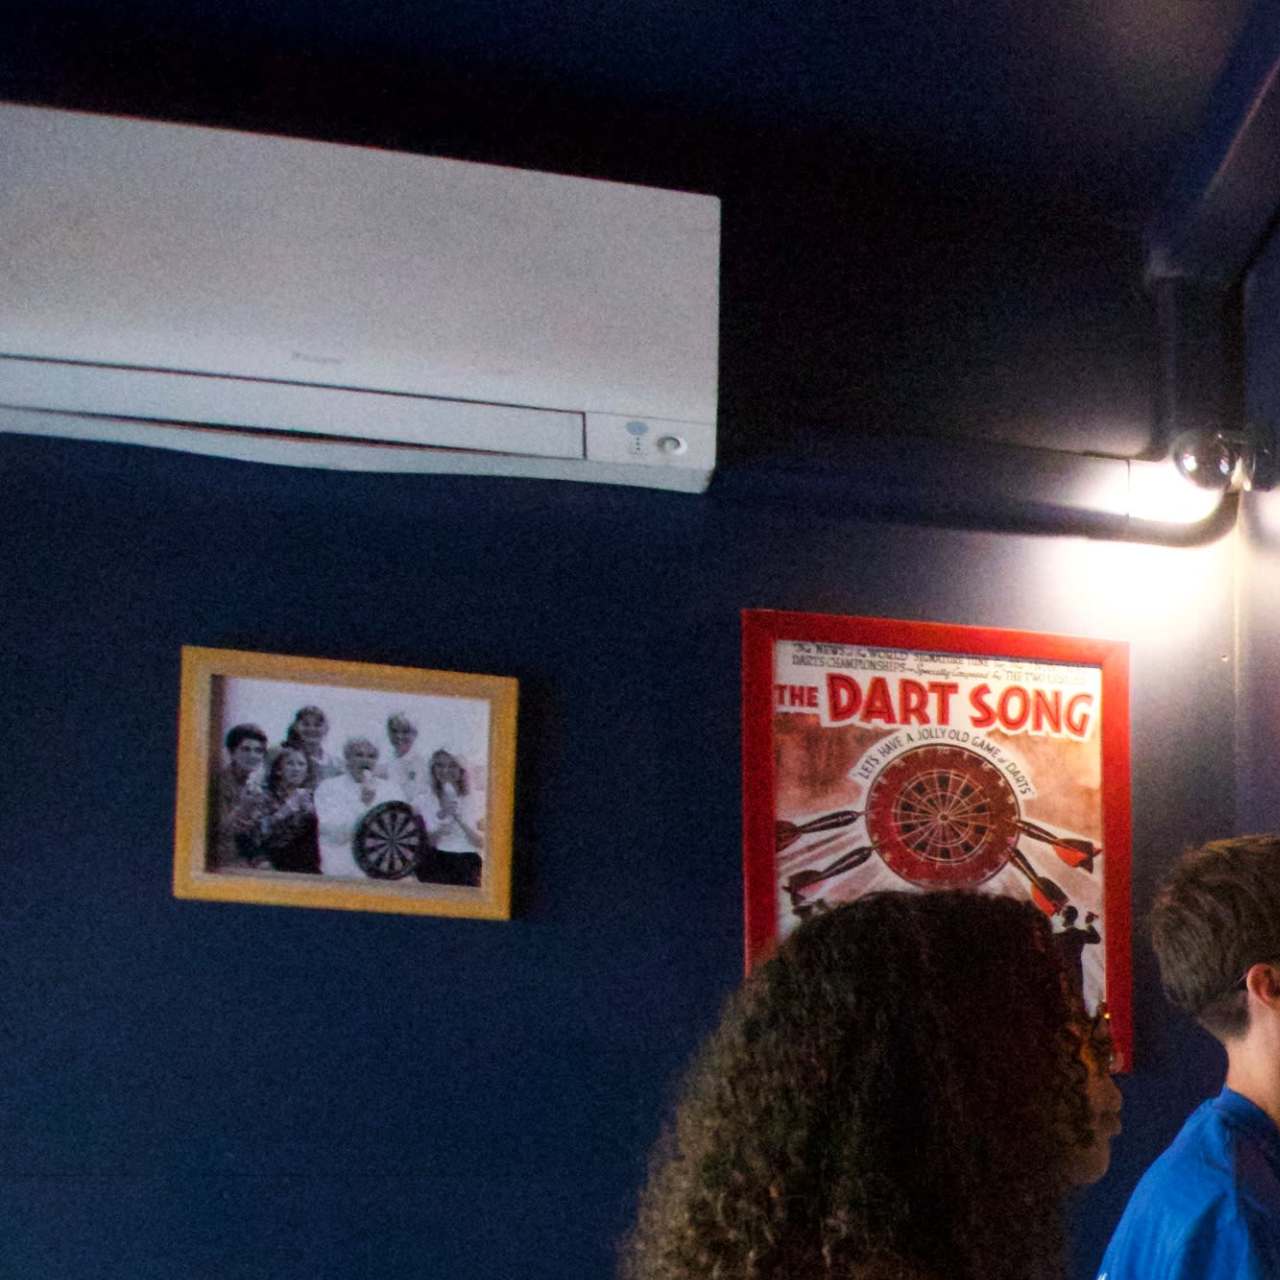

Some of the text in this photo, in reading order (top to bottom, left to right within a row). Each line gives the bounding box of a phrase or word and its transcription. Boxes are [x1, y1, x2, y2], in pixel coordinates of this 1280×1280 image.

[775, 672, 1095, 737] THE DART SONG
[878, 736, 903, 758] HAVE
[904, 733, 915, 745] A
[916, 728, 946, 744] JOLLY
[947, 728, 971, 744] OLD
[971, 736, 1002, 760] GAME
